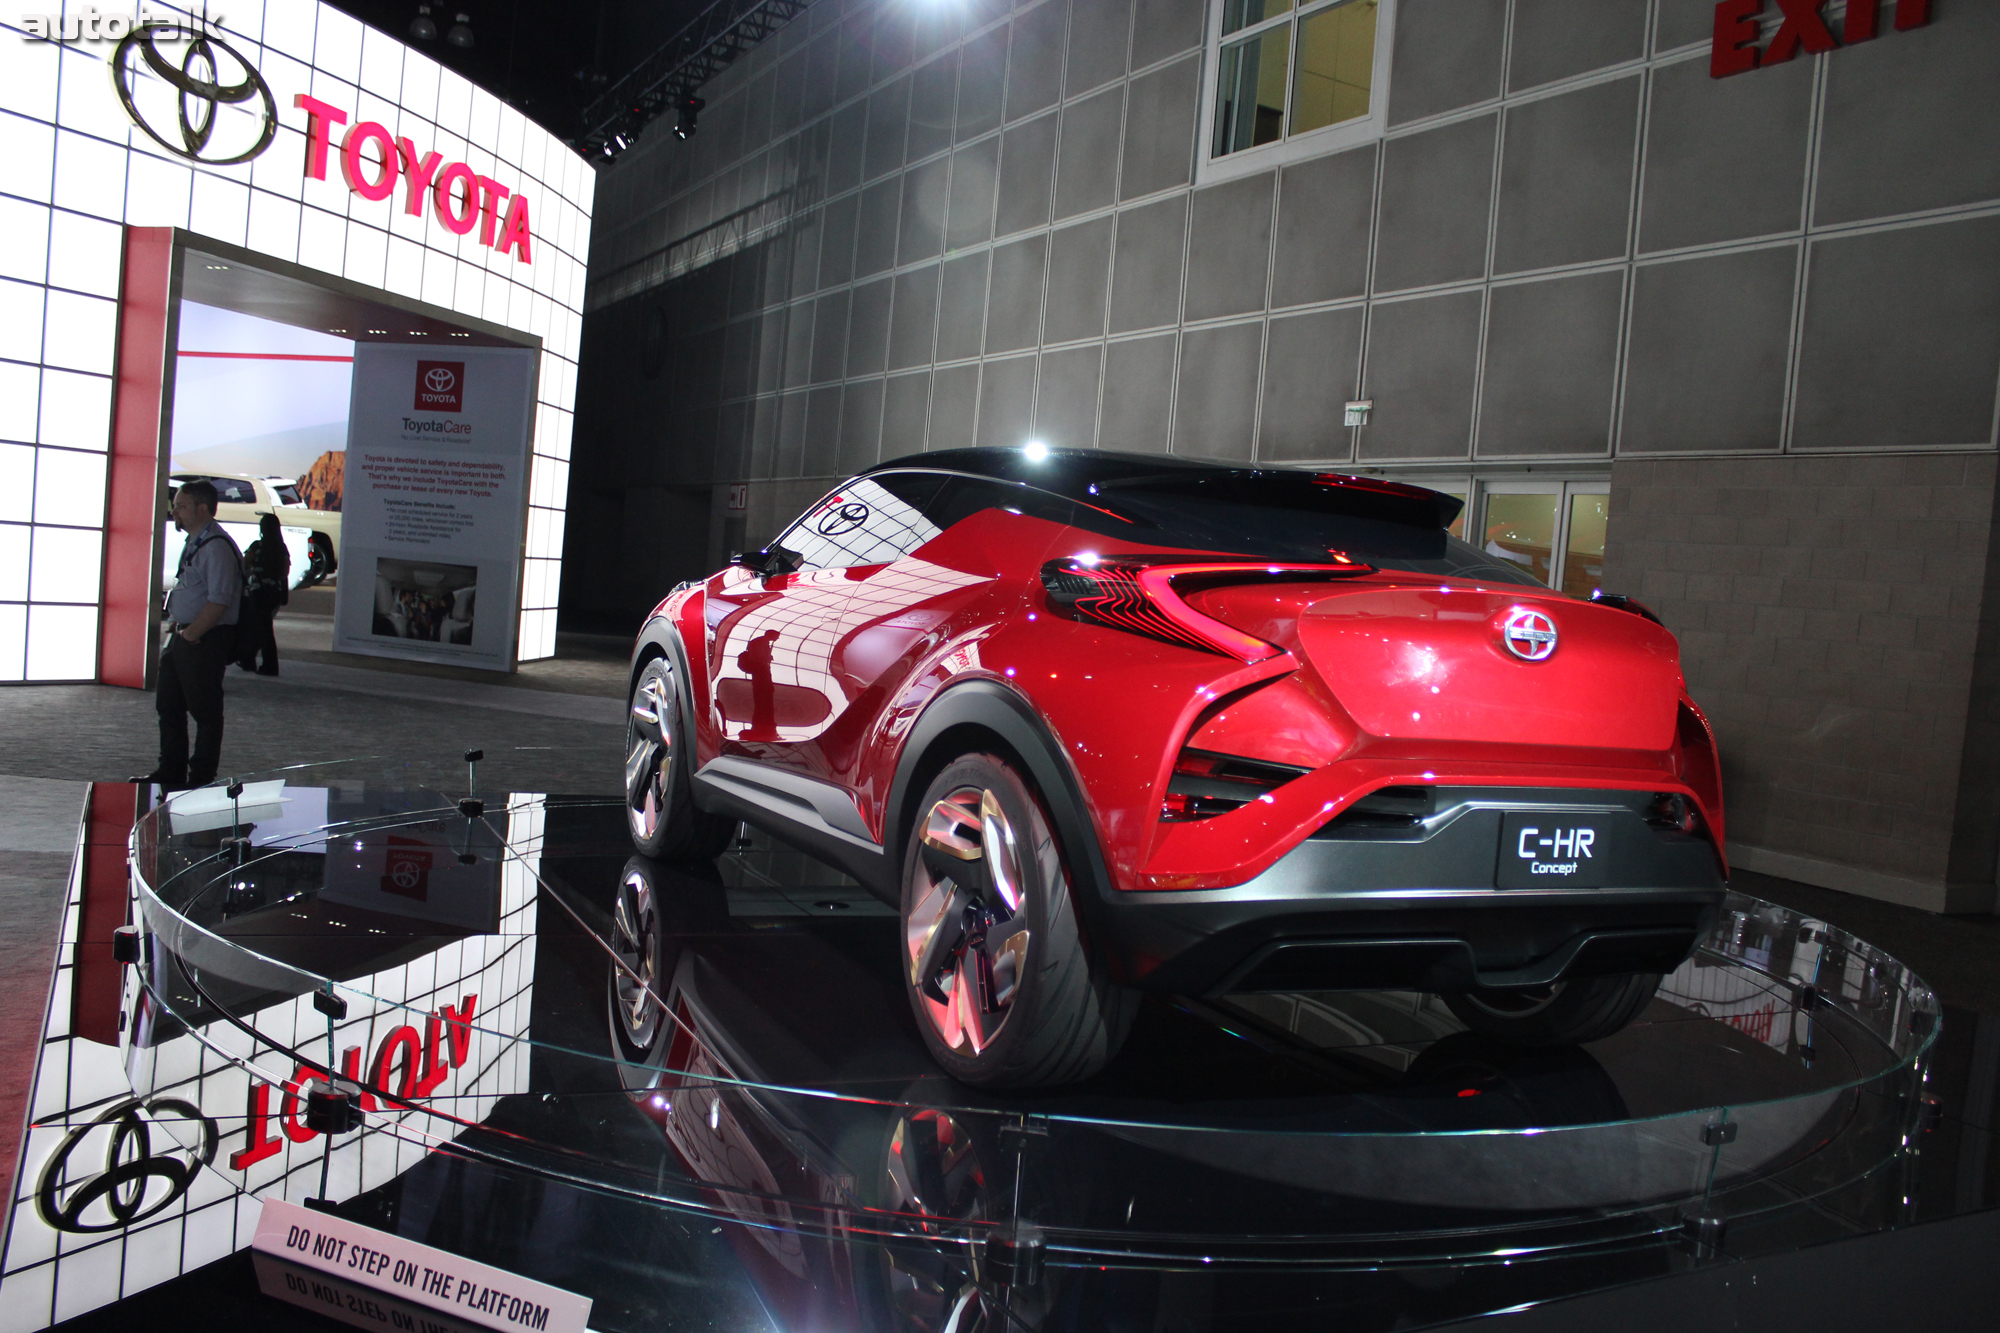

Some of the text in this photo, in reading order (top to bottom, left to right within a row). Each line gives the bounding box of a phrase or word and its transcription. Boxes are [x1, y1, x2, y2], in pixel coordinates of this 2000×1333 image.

[294, 93, 532, 265] TOYOTA
[421, 393, 456, 404] TOYOTA
[402, 417, 472, 434] ToyotaCare
[394, 457, 419, 465] devoted
[428, 460, 447, 468] safety
[375, 465, 395, 473] proper
[451, 470, 481, 478] important
[437, 478, 472, 486] ToyotaCare
[1518, 827, 1595, 858] C-HR
[1531, 861, 1579, 877] Concept
[286, 1225, 550, 1331] DO NOT STEP ON THE PLATFORM
